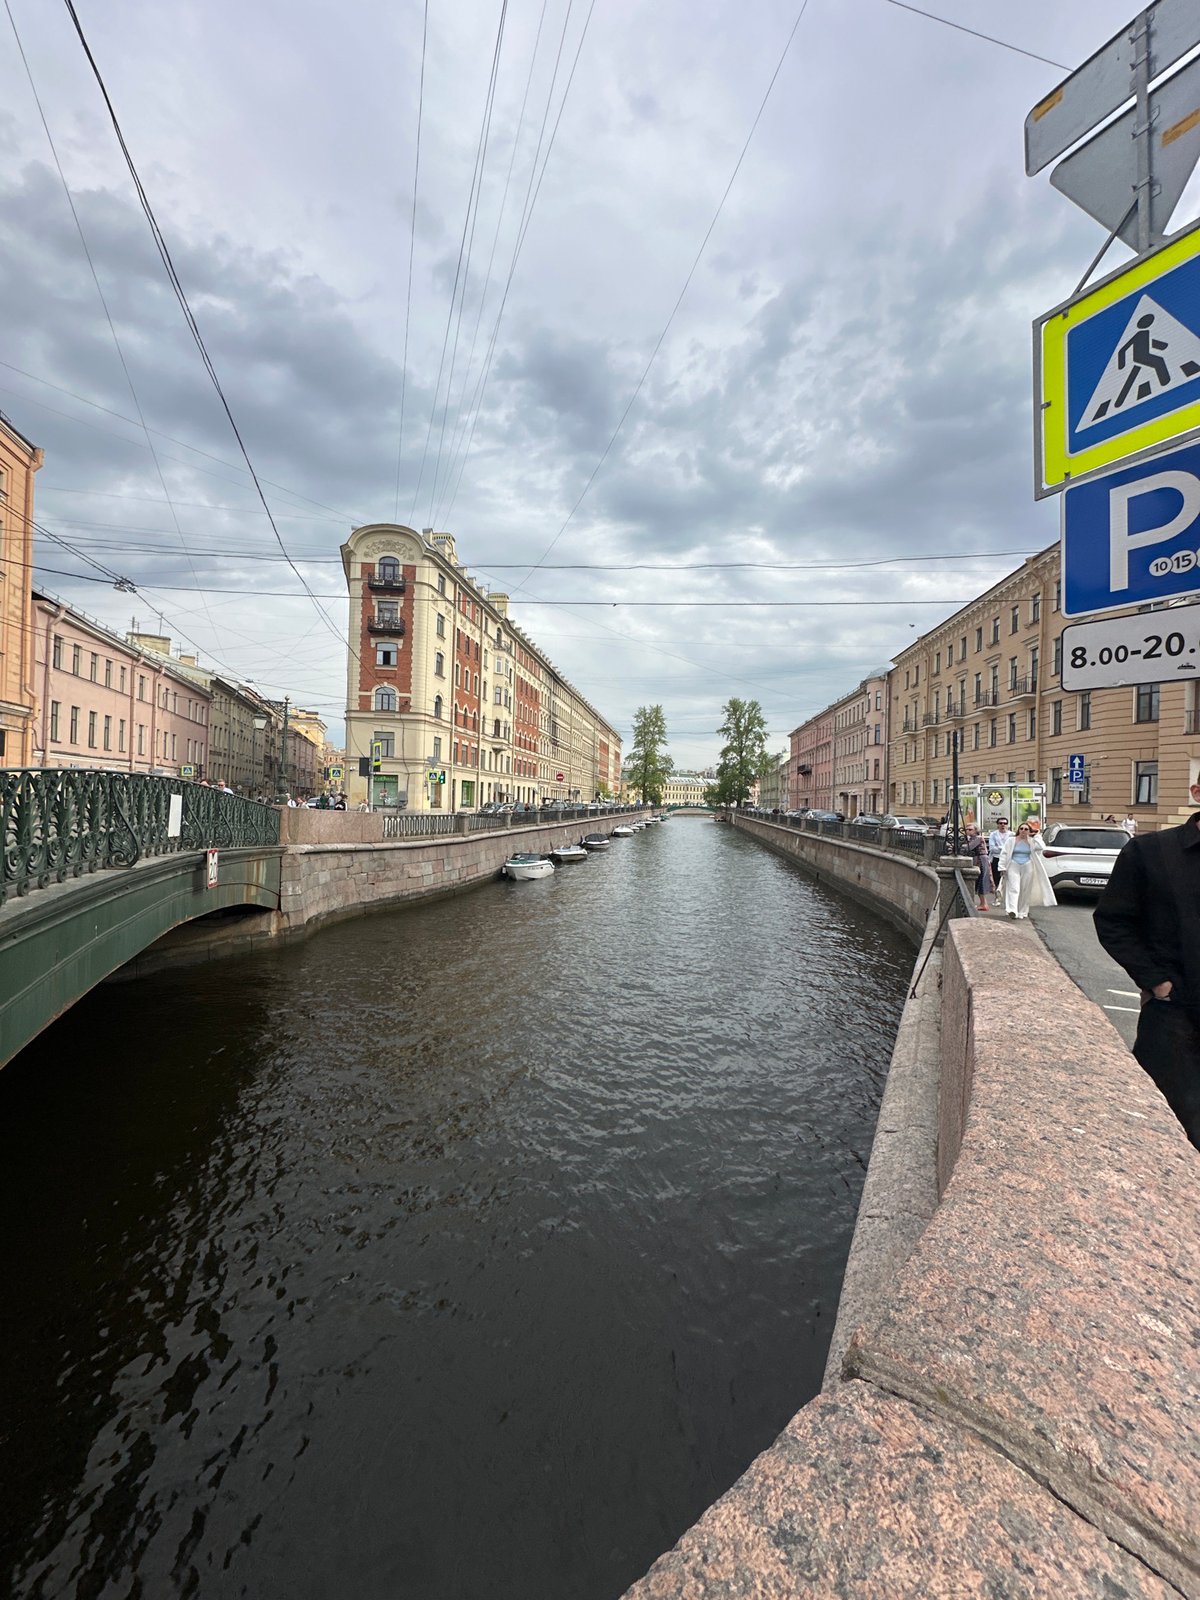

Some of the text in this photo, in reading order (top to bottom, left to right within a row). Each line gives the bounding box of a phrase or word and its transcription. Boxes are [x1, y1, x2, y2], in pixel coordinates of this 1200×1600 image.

[1109, 470, 1200, 592] P
[1154, 553, 1192, 573] 10 15
[1070, 632, 1200, 669] 8.00-20.
